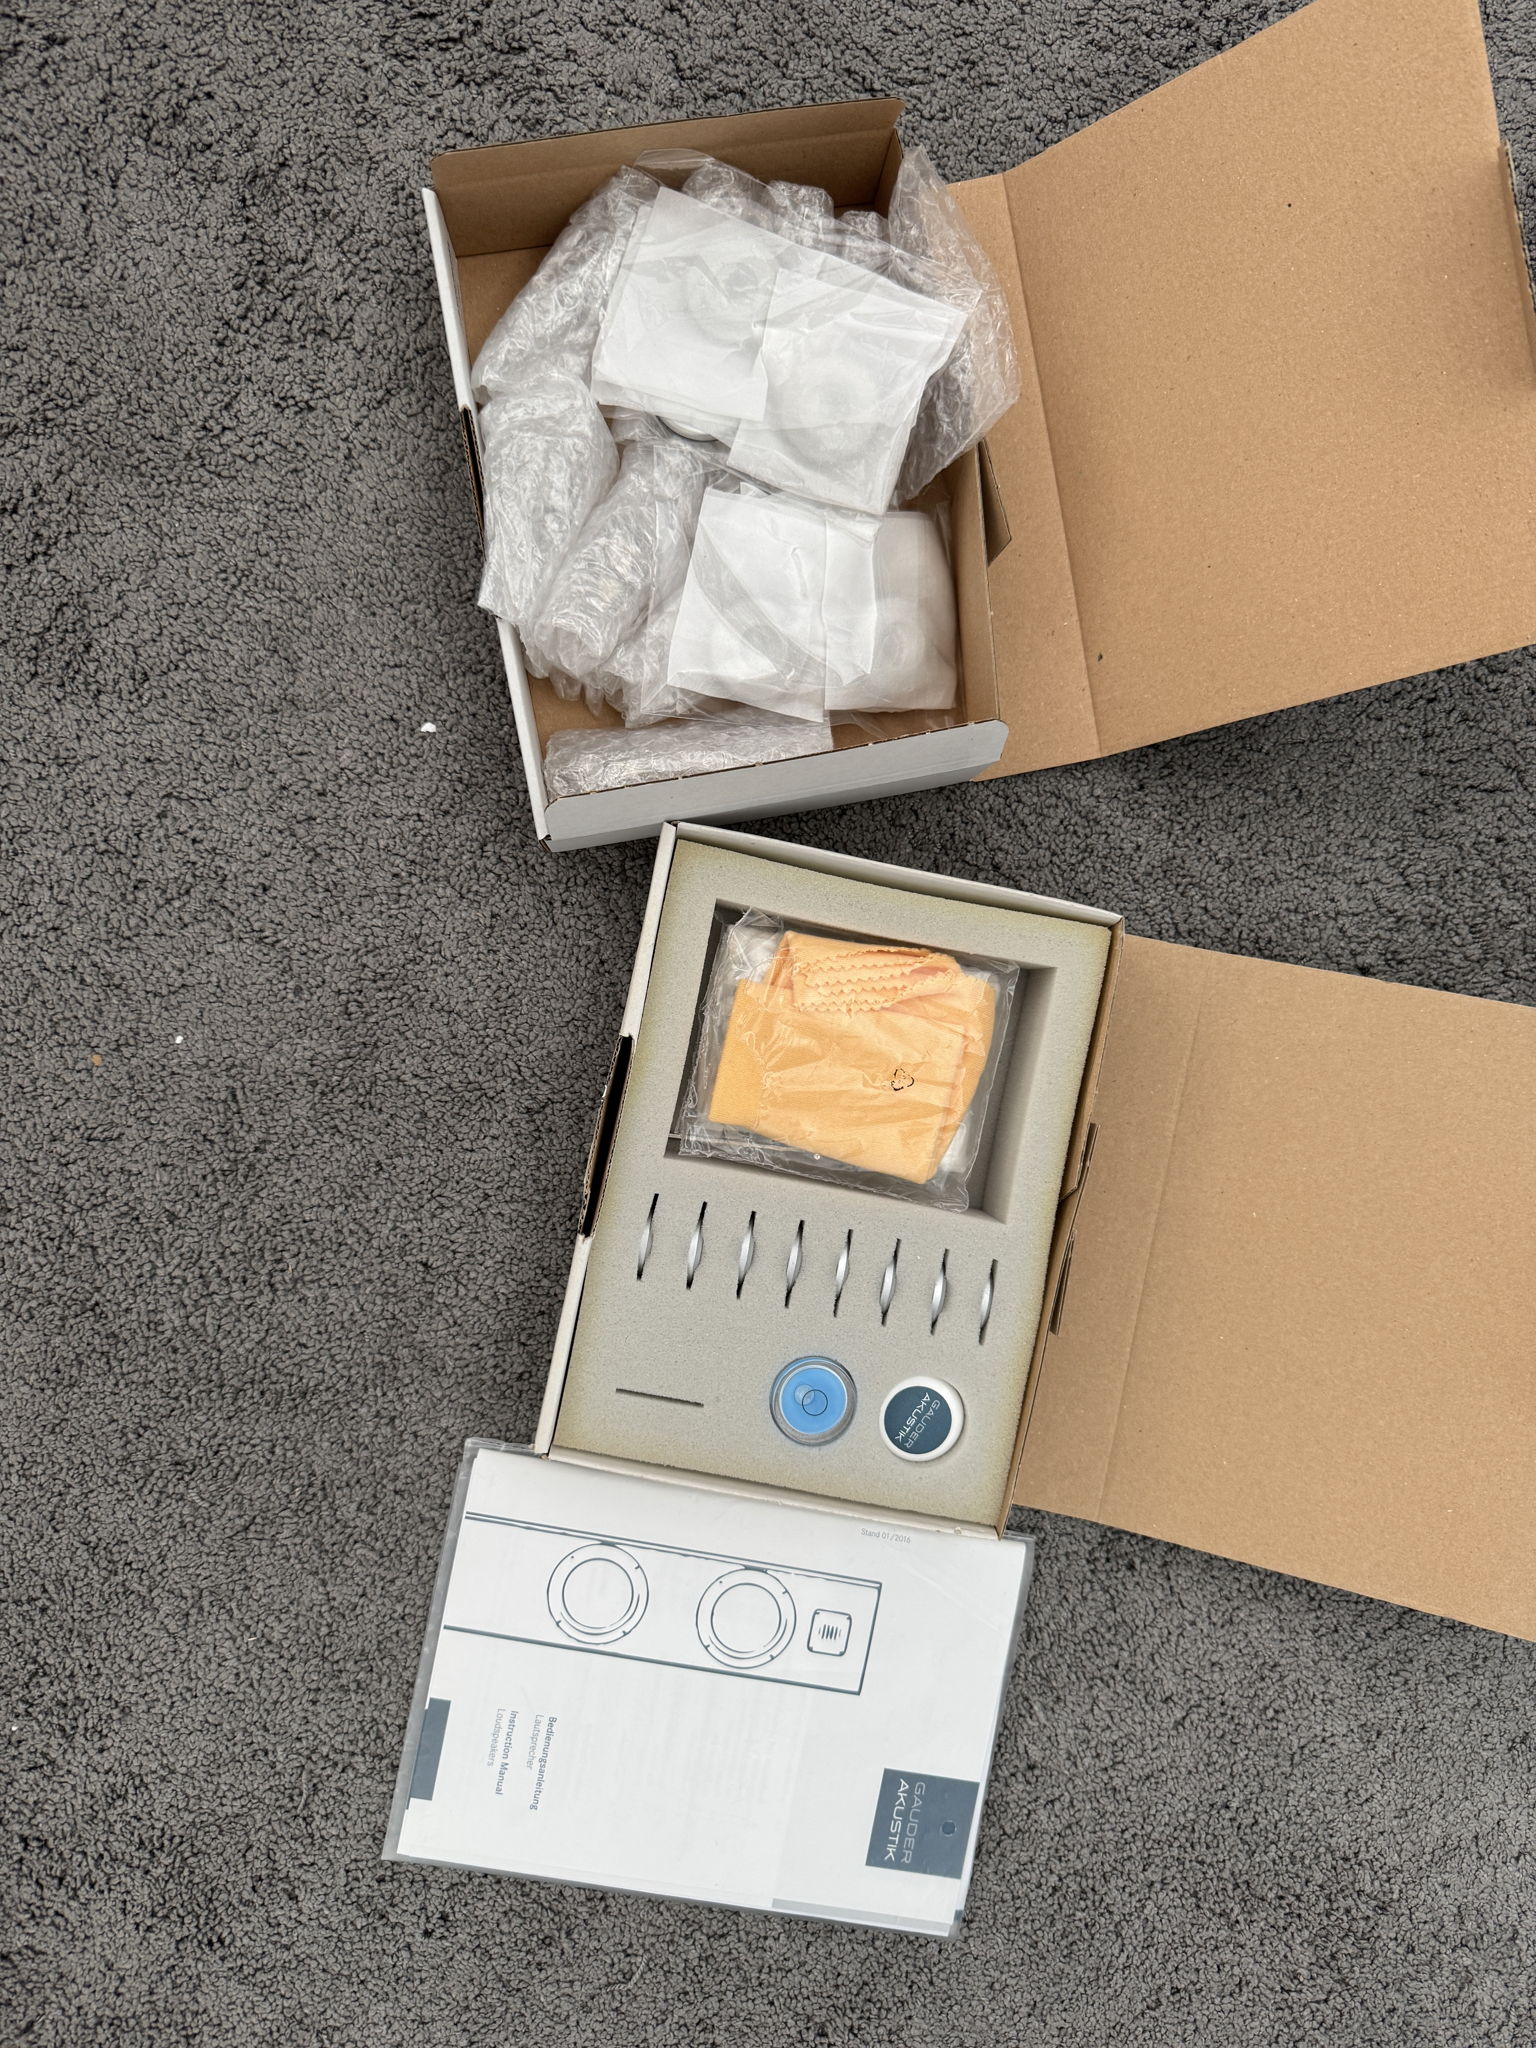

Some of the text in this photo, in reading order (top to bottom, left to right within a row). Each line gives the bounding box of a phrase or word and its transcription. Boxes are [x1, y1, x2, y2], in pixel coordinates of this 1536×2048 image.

[895, 1392, 931, 1442] AKUSTIK
[904, 1399, 940, 1448] GAUDER
[861, 1527, 880, 1538] Stand
[487, 1708, 506, 1767] Loudspeakers
[495, 1710, 519, 1795] Instruction Manual
[526, 1714, 544, 1770] Lautsprecher
[529, 1716, 557, 1811] Bedienungsanleitung
[884, 1778, 909, 1861] AKUSTIK
[901, 1782, 926, 1864] GAUDER
